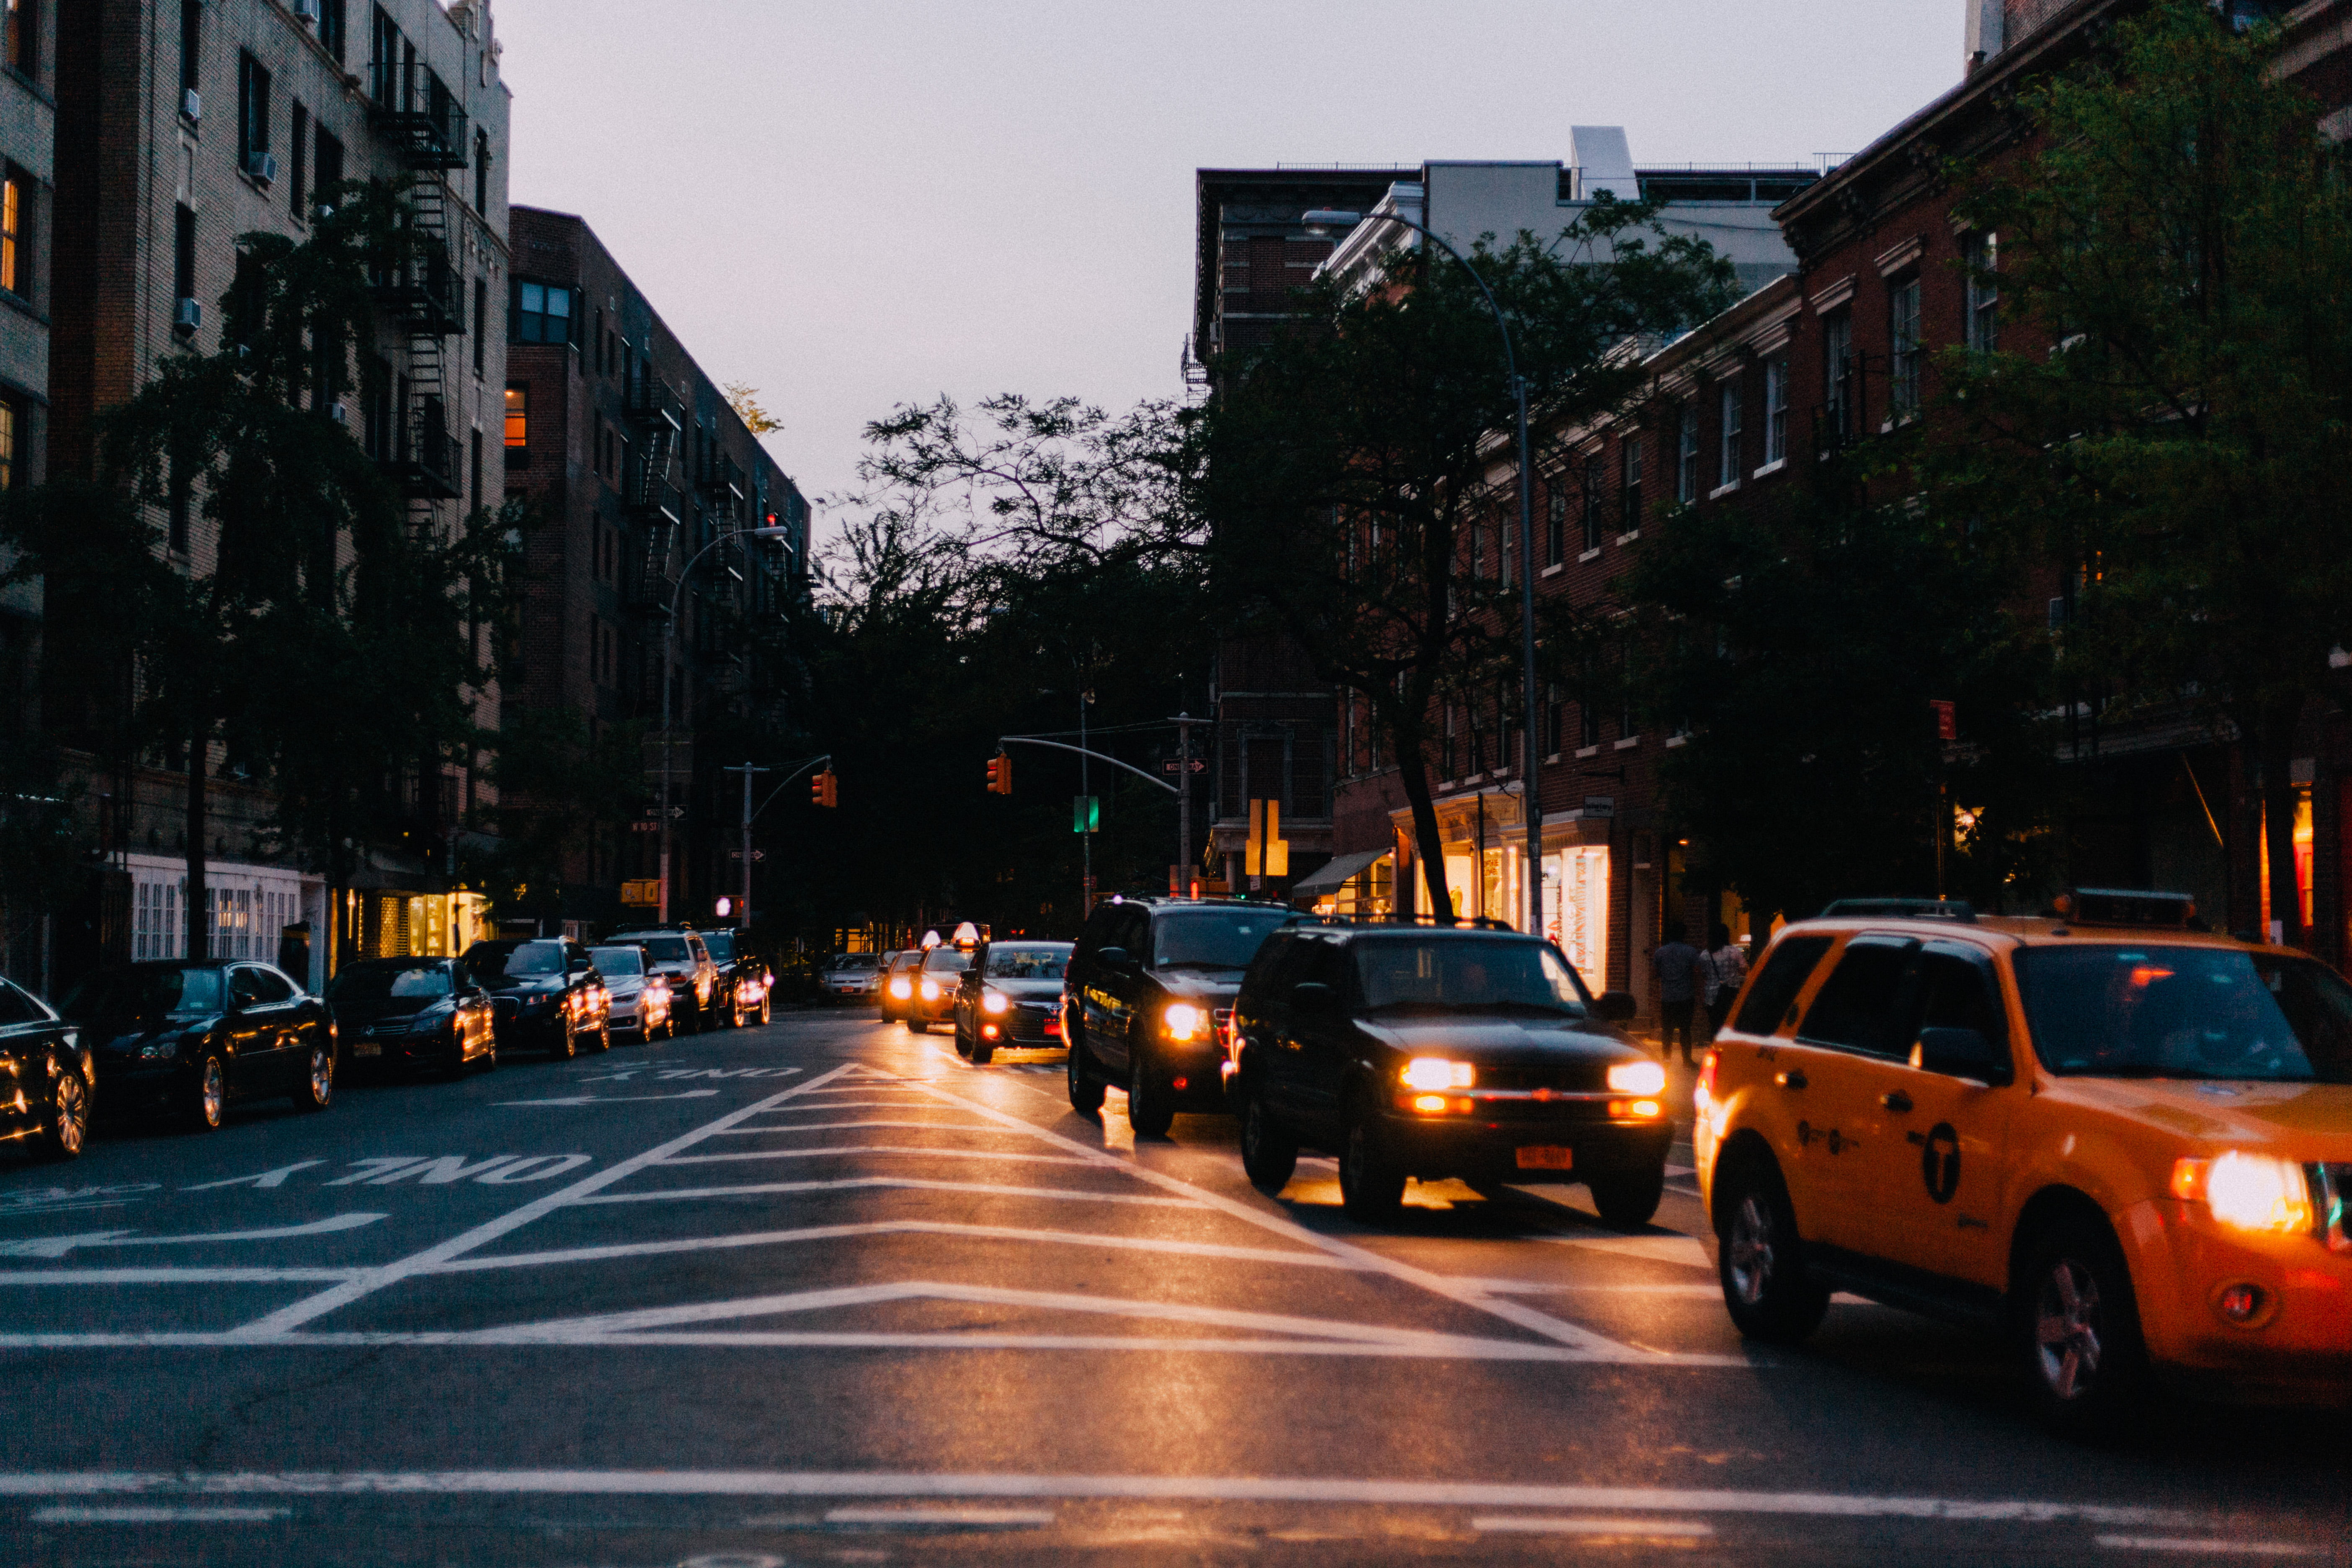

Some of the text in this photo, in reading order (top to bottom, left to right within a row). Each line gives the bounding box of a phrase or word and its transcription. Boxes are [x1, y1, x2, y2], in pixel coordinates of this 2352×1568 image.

[632, 822, 657, 831] W 10 ST
[574, 1067, 804, 1082] ONLY
[178, 1154, 593, 1191] ONLY
